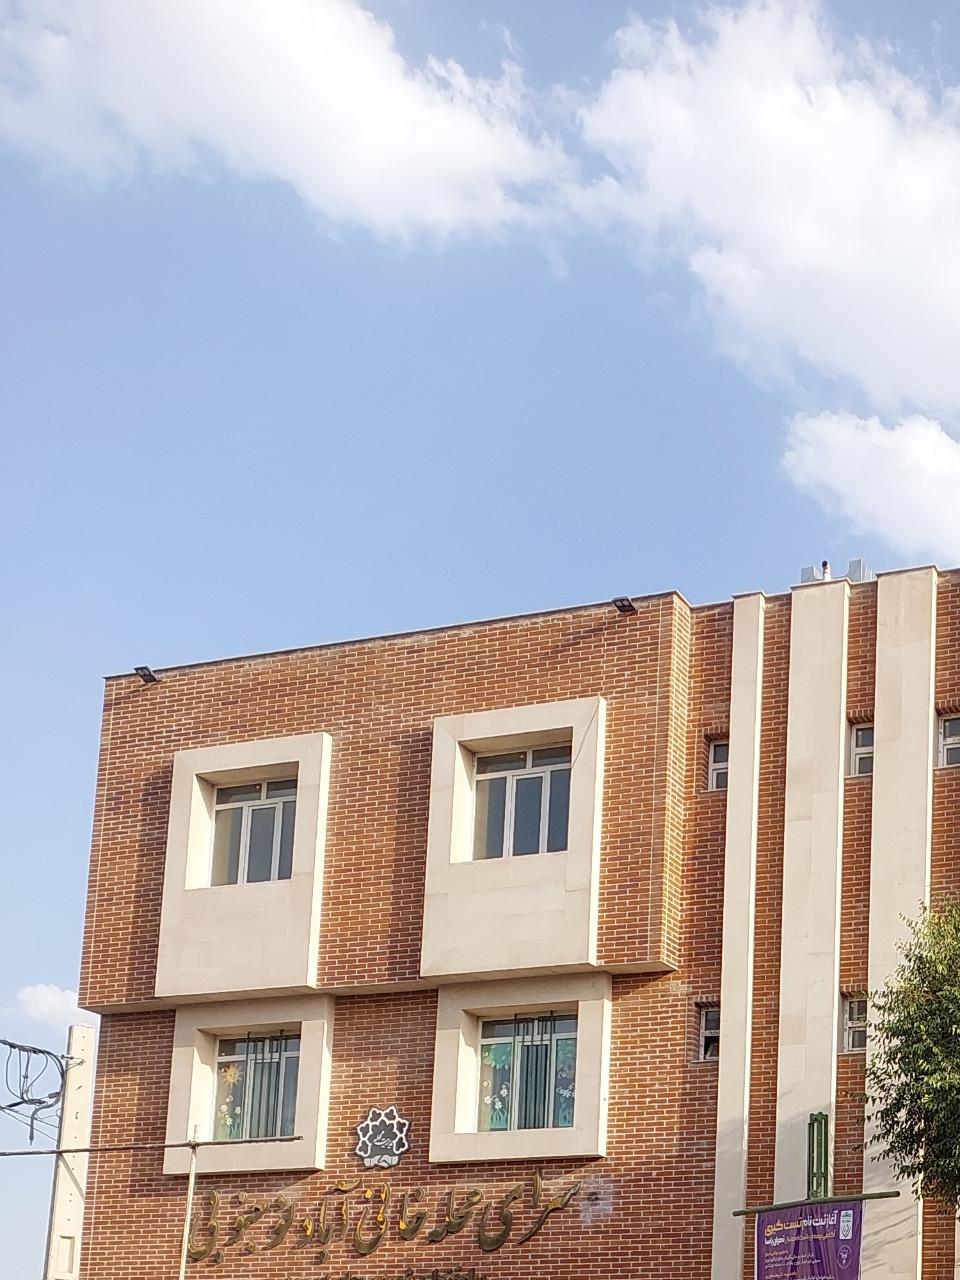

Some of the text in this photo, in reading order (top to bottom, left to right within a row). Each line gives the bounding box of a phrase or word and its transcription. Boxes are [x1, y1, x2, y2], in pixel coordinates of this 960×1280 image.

[187, 1189, 269, 1265] جنوبی
[426, 1187, 484, 1246] محله
[478, 1172, 585, 1253] سرای
[764, 1210, 838, 1237] آغاز ثبت نام تست گیری
